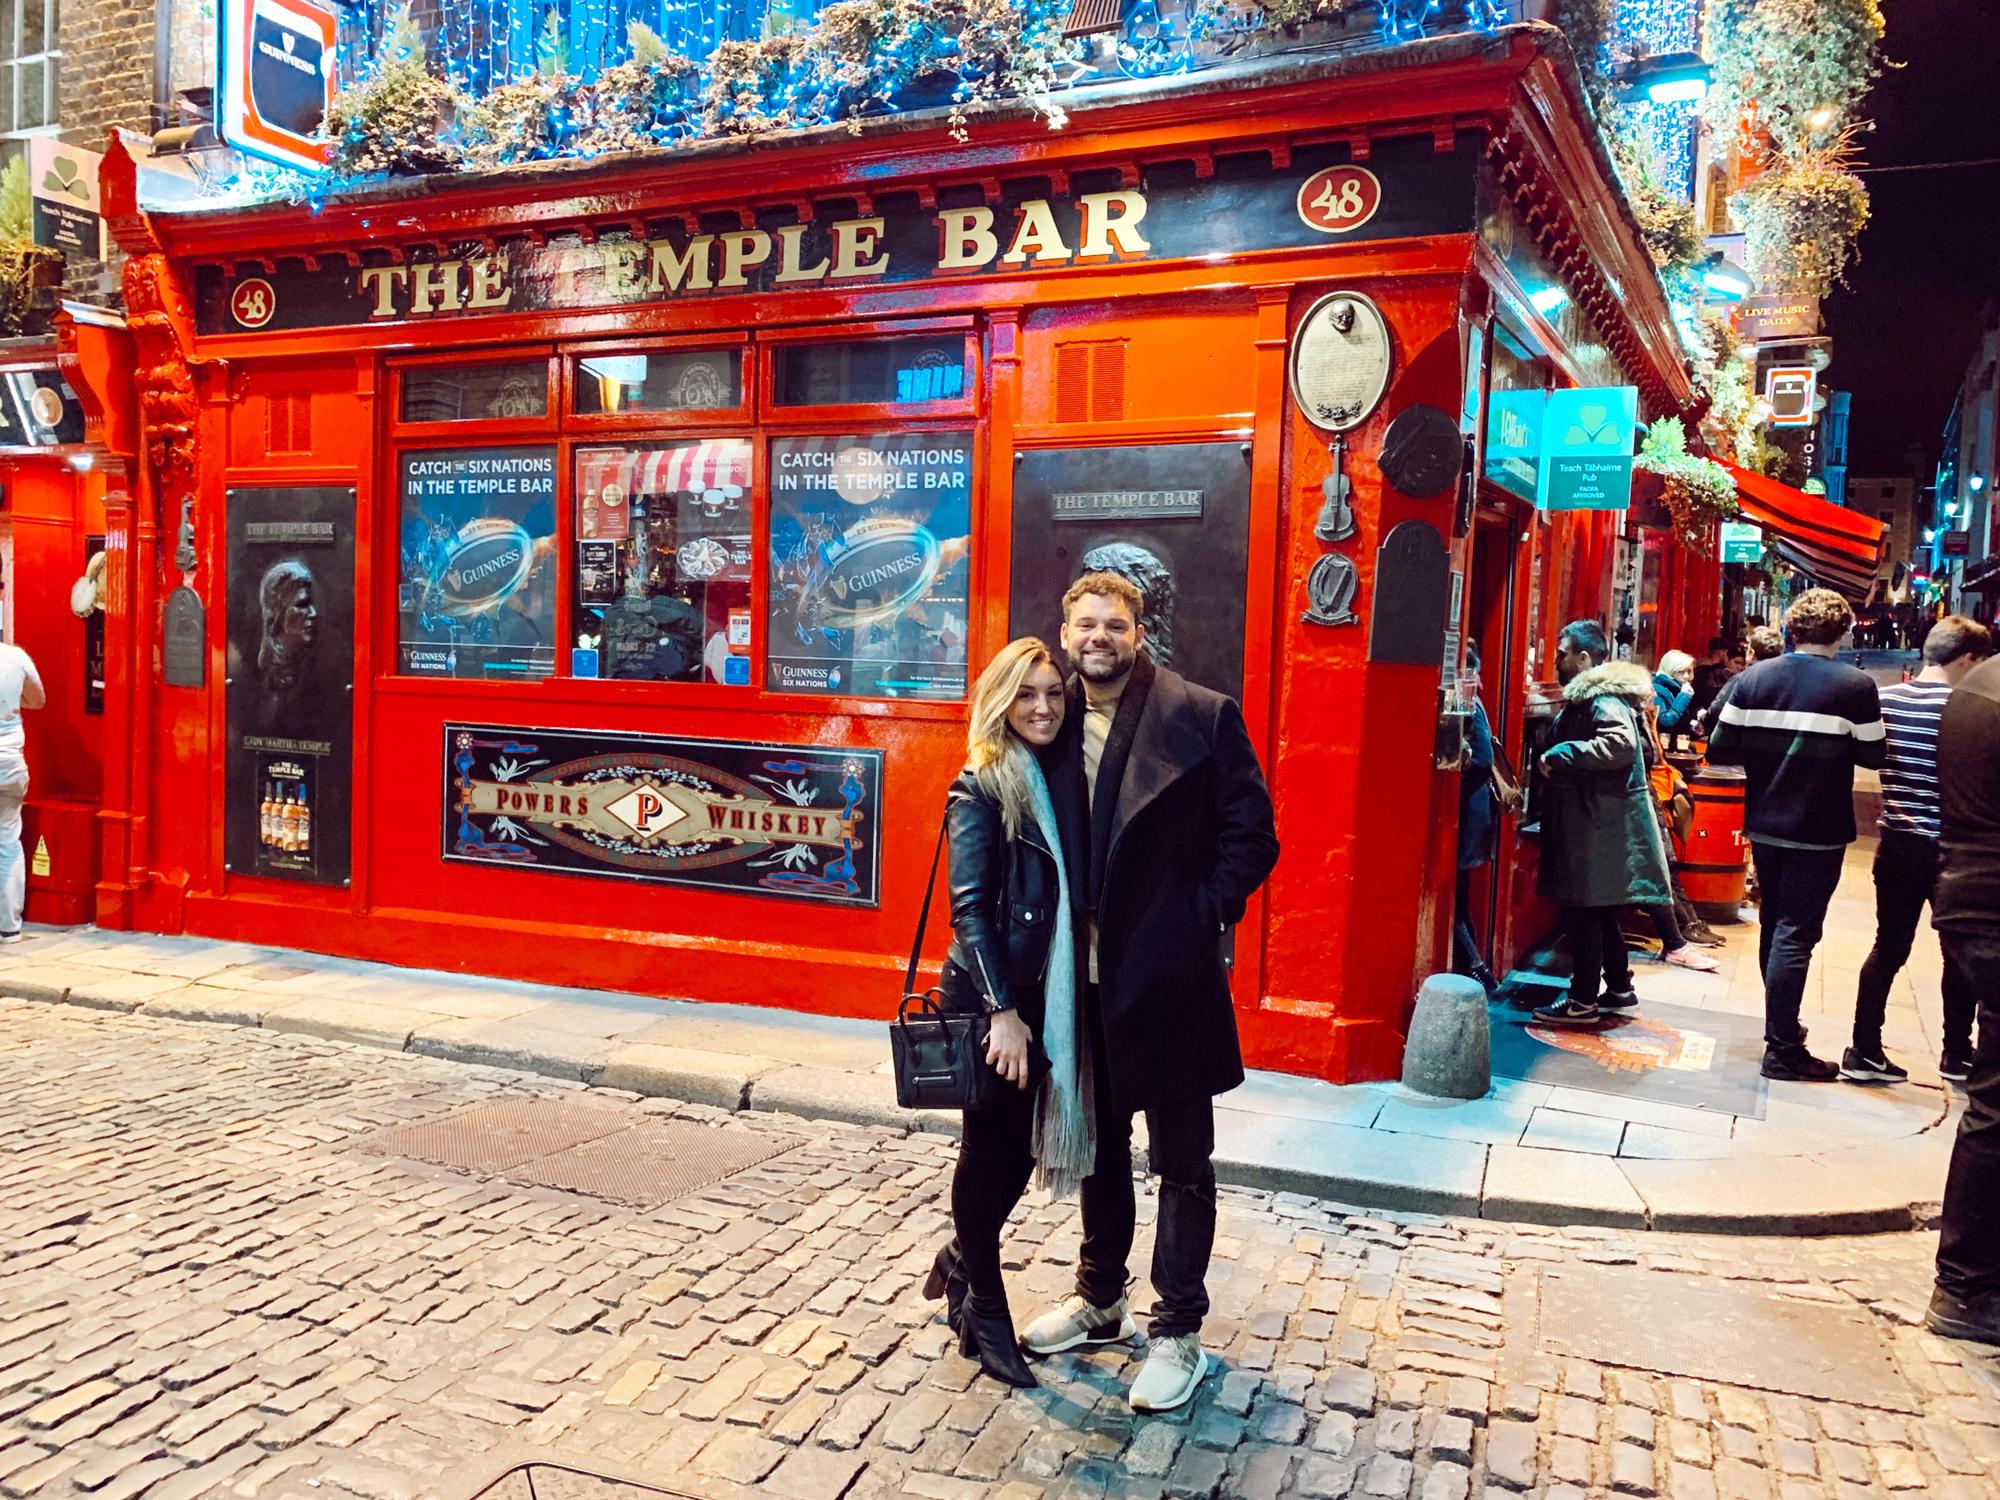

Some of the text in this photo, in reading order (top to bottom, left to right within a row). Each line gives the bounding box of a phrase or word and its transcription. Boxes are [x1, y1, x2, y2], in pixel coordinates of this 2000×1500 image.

[258, 41, 316, 76] GUINNESS
[1310, 178, 1365, 220] 48
[362, 190, 1151, 319] THE TEMPLE BAR
[239, 290, 266, 320] 48
[1745, 304, 1811, 317] LIVE MUSIC
[1759, 317, 1793, 327] DAILY
[409, 460, 452, 476] CATCH
[468, 460, 489, 475] SIX
[491, 458, 552, 473] NATIONS
[781, 452, 835, 468] CATCH
[857, 450, 884, 467] SIX
[887, 449, 964, 466] NATIONS
[1560, 463, 1582, 472] Teach
[408, 477, 553, 495] IN THE TEMPLE BAR
[779, 471, 965, 490] IN THE TEMPLE BAR
[1582, 473, 1597, 481] Pub
[1054, 491, 1201, 510] THE TEMPLE BAR
[462, 549, 520, 585] GUINNESS
[849, 552, 922, 592] GUINNESS
[410, 650, 447, 661] GUINNESS
[420, 663, 446, 671] NATIONS
[782, 665, 828, 679] GUINNESS
[782, 679, 828, 689] SIX NATIONS
[496, 788, 590, 817] POWERS
[636, 792, 664, 831] P
[707, 803, 827, 838] WHISKEY
